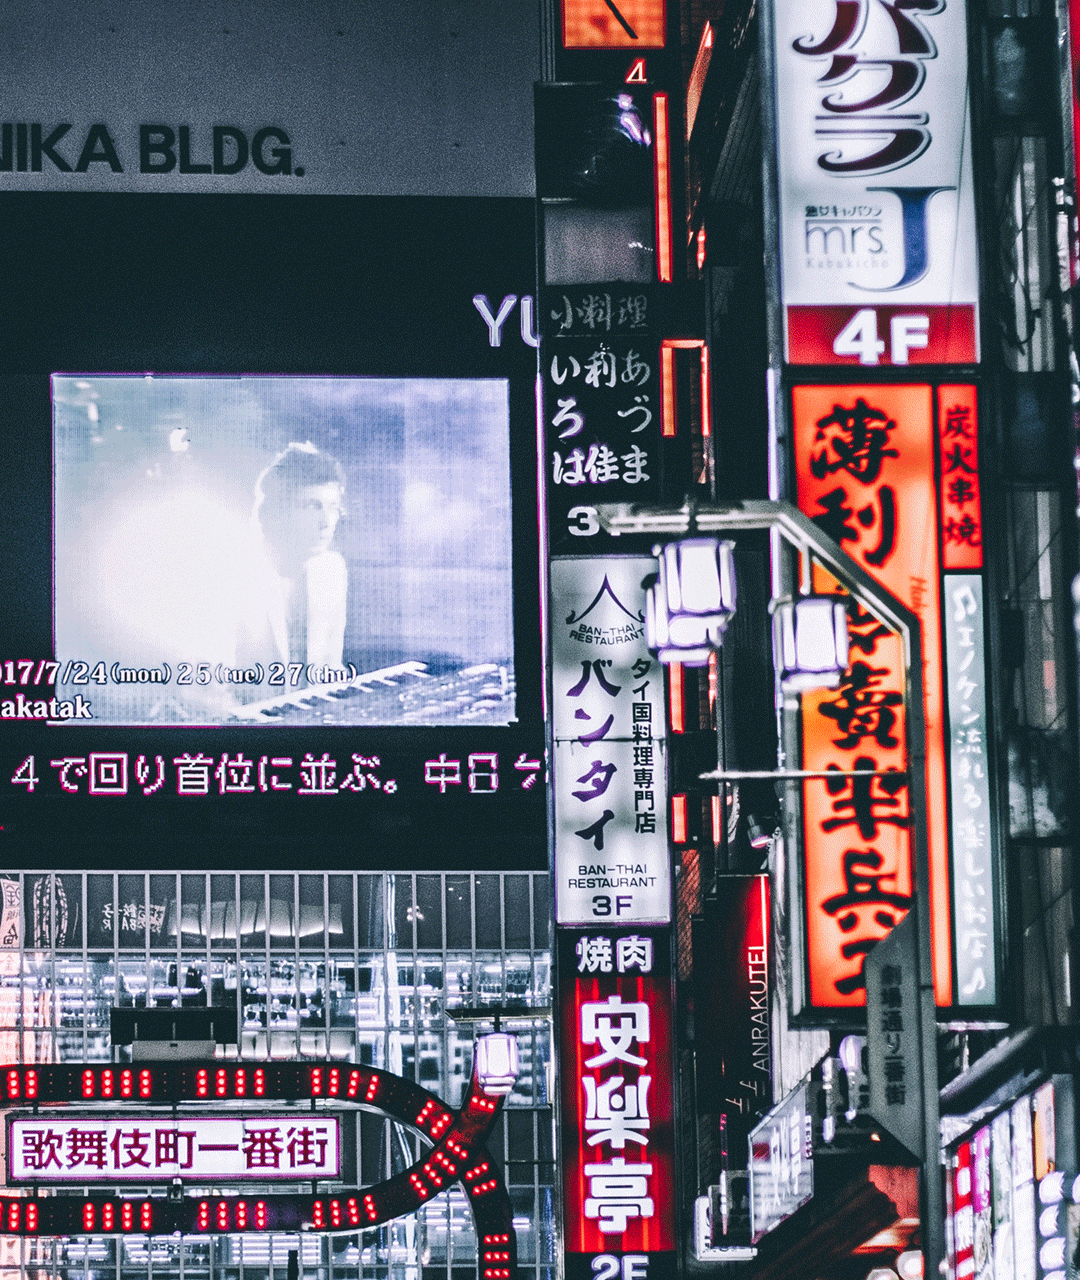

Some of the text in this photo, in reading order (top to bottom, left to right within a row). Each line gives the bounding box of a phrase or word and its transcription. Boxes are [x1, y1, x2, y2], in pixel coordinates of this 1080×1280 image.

[625, 59, 648, 84] 4
[139, 125, 306, 177] BLDG.
[833, 310, 931, 367] 4F
[569, 627, 645, 645] RESTAURANT
[579, 623, 635, 636] BAN-THAI
[566, 659, 622, 852] バンタイ
[631, 658, 657, 836] タイ国料理専門店
[568, 876, 657, 890] RESTAURANT
[578, 864, 648, 877] BAN-THAI
[591, 895, 634, 919] 3F
[575, 935, 654, 975] 焼肉
[580, 994, 657, 1236] 安楽亭
[21, 1126, 331, 1172] 歌舞伎町一番街
